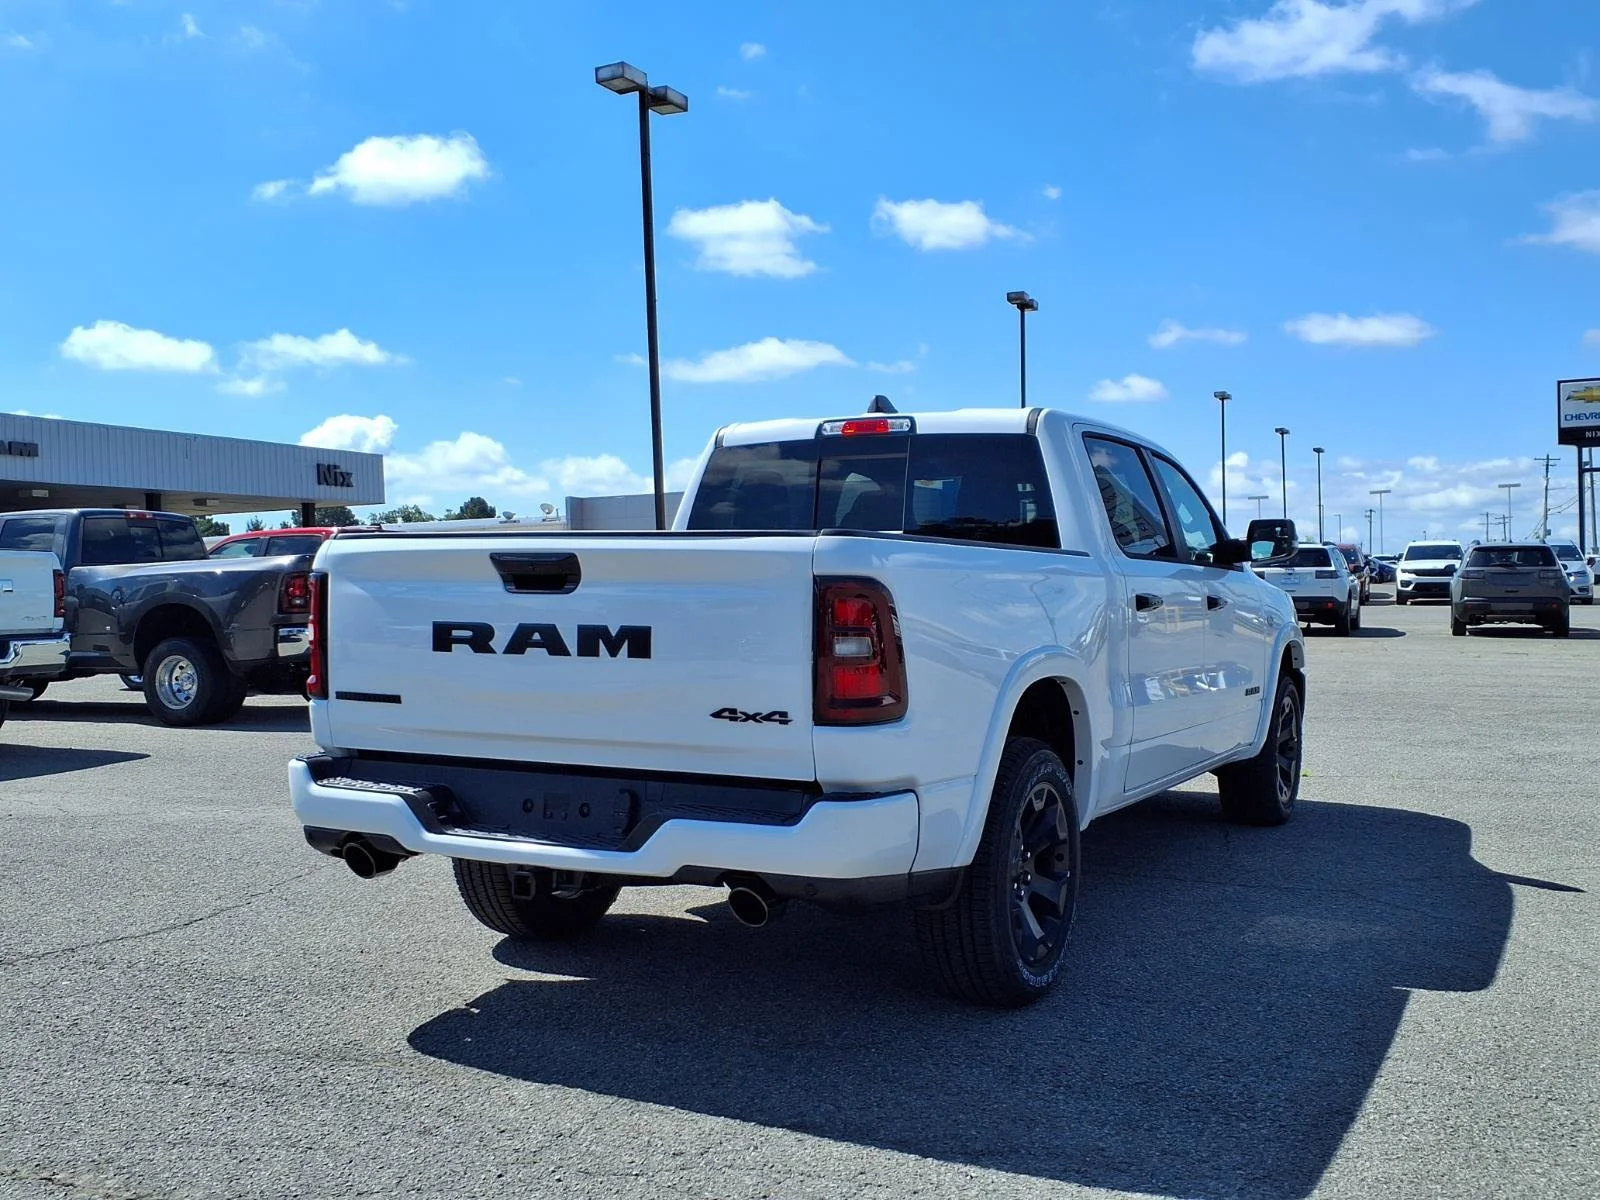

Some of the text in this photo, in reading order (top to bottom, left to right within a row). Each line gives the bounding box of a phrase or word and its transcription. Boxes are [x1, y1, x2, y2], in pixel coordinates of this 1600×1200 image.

[1564, 411, 1600, 421] CHEVR
[316, 463, 354, 488] Nix
[432, 620, 652, 659] RAM
[709, 707, 794, 725] 4x4
